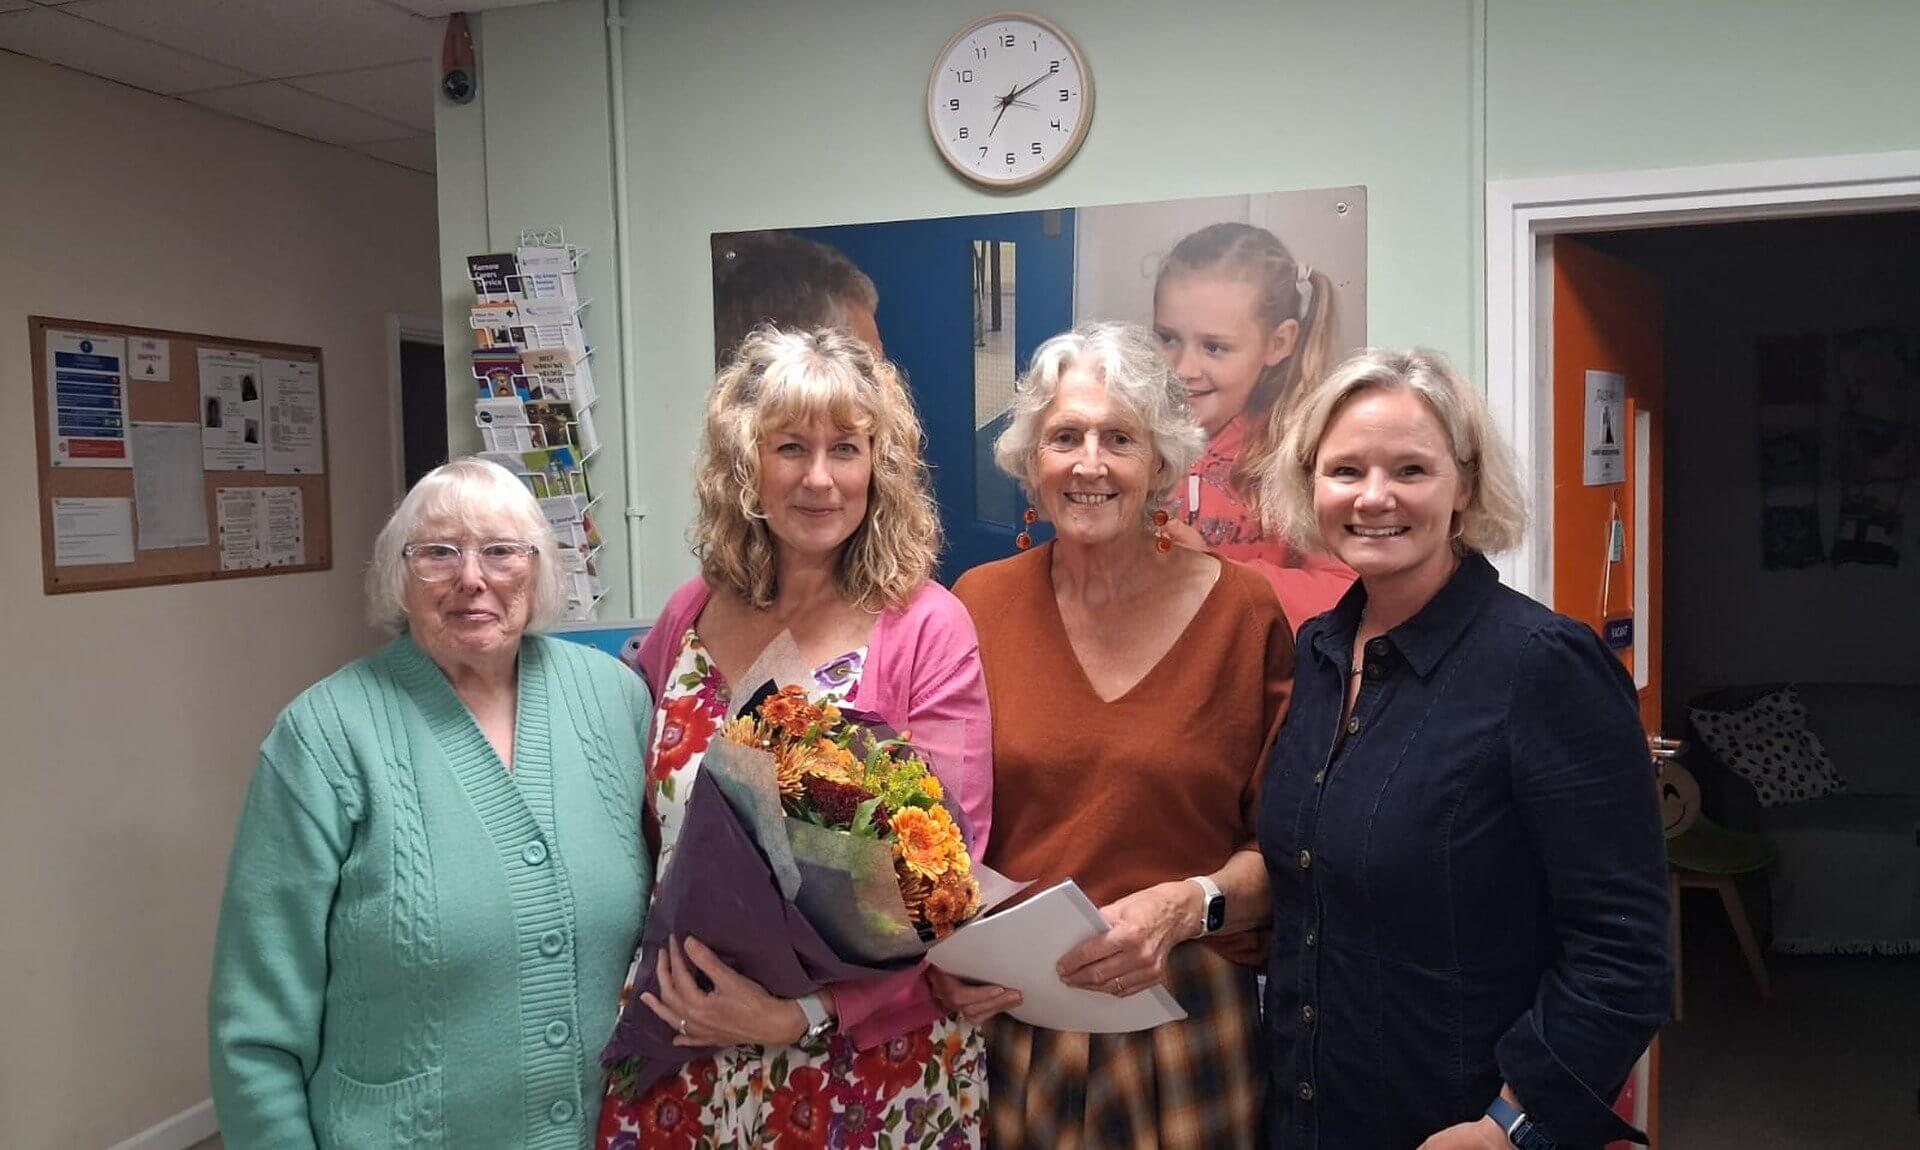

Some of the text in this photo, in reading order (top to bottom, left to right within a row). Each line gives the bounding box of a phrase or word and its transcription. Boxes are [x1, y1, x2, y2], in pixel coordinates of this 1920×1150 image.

[999, 35, 1015, 47] 12
[1032, 40, 1038, 52] 1
[975, 48, 987, 59] 11
[1049, 61, 1060, 74] 2
[956, 70, 973, 83] 10
[1059, 89, 1069, 101] 3
[950, 99, 960, 111] 9
[1050, 119, 1061, 131] 4
[959, 127, 969, 139] 8
[979, 147, 988, 158] 7
[1031, 142, 1042, 154] 5
[1006, 153, 1015, 164] 6
